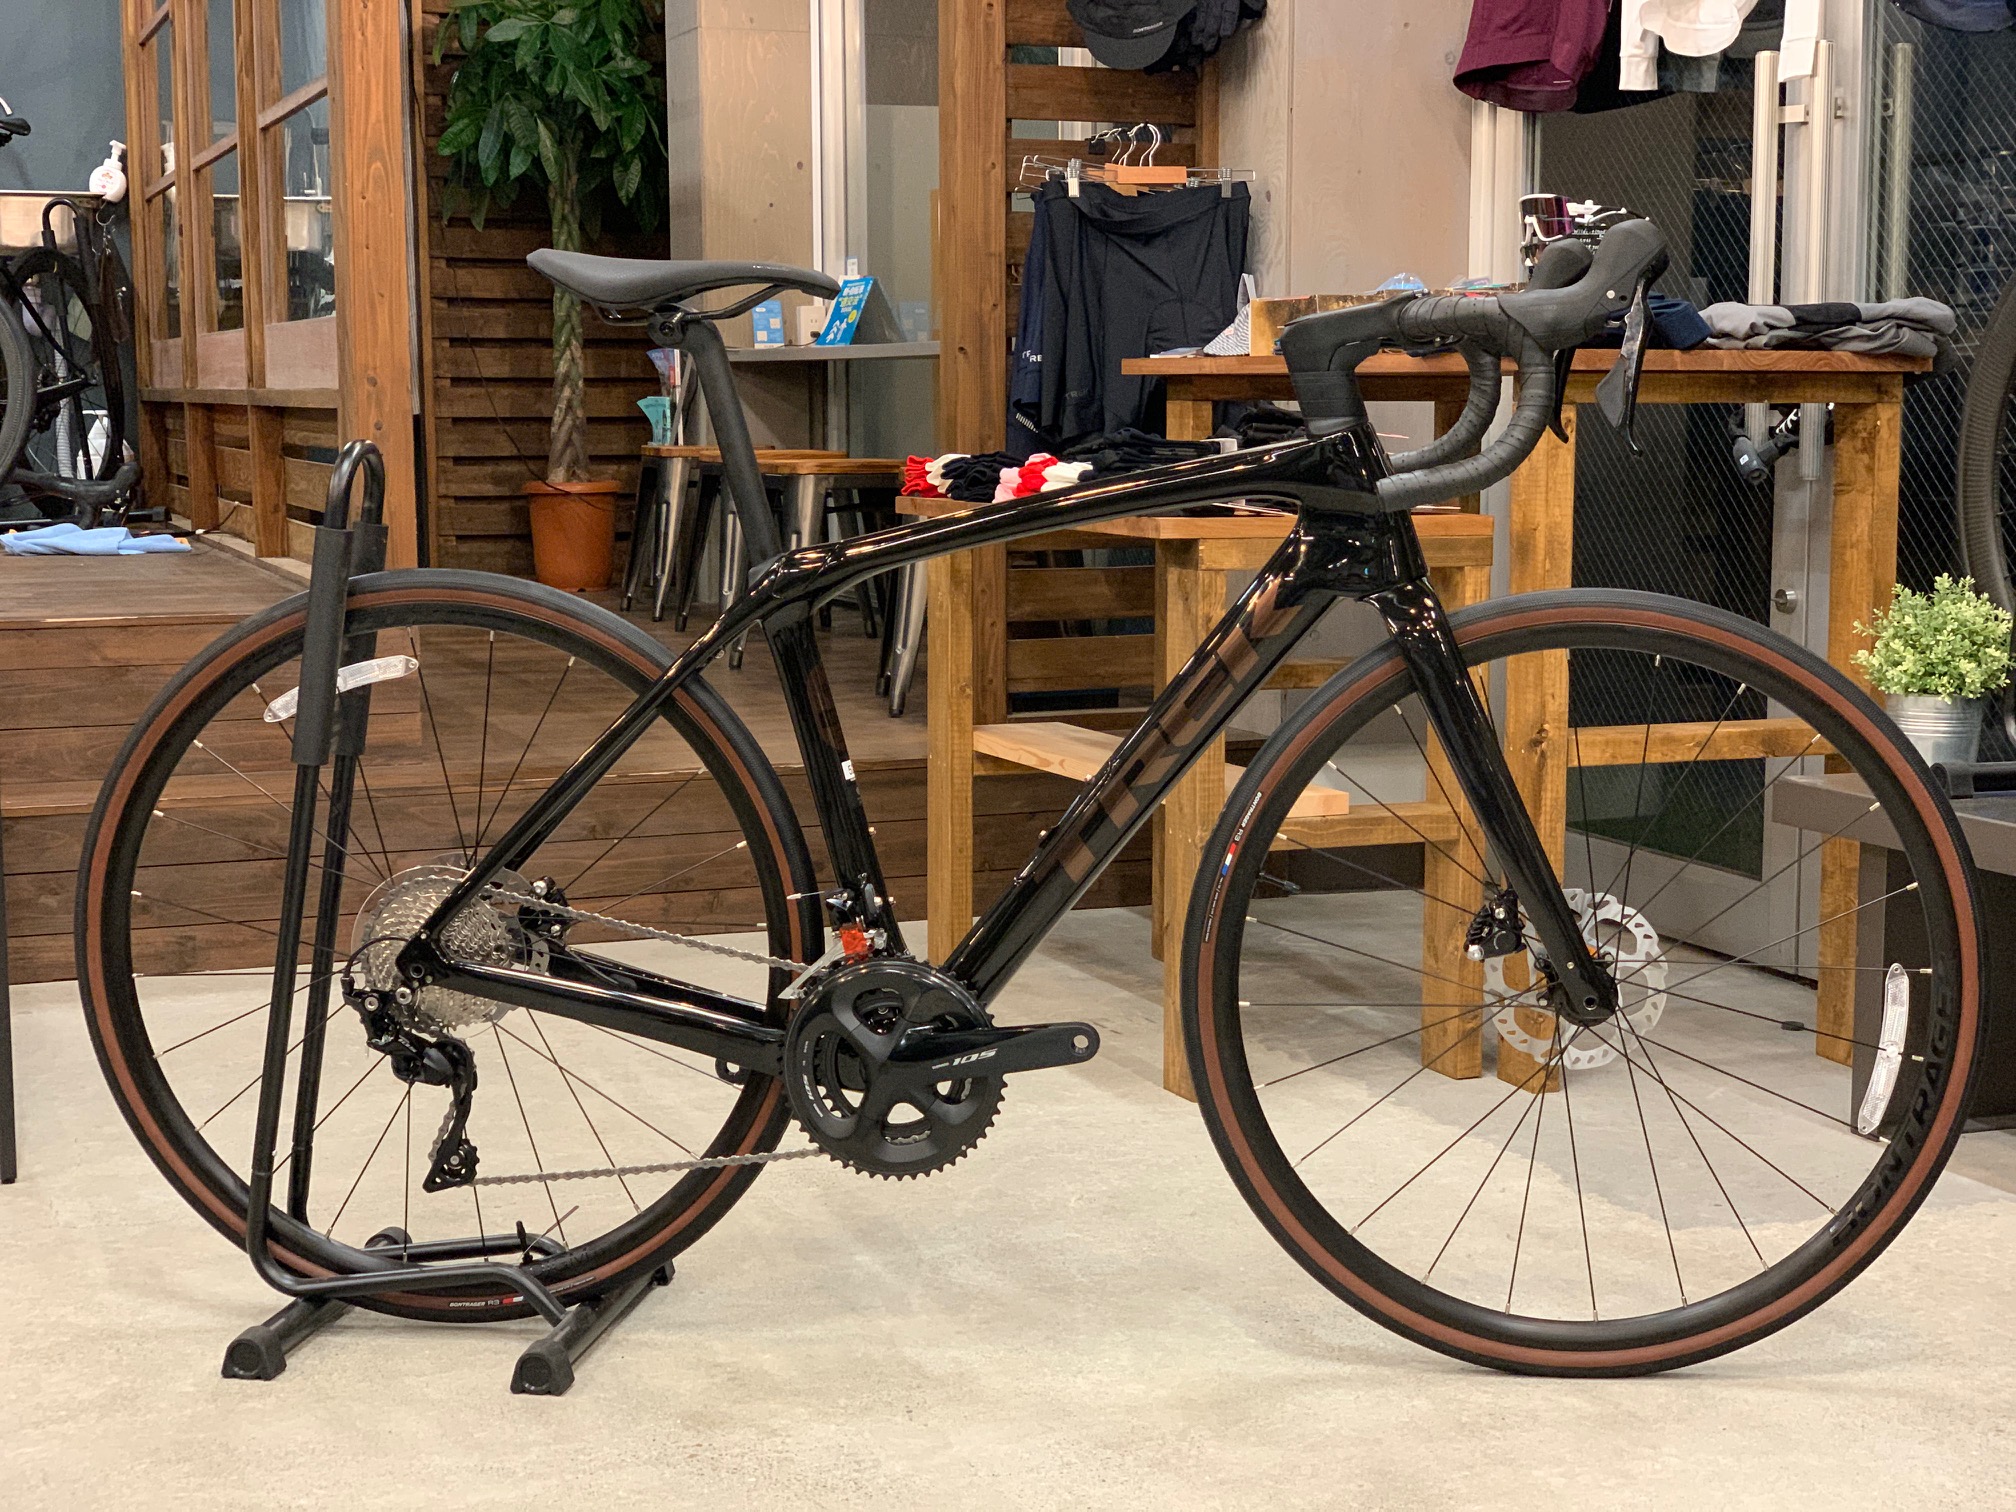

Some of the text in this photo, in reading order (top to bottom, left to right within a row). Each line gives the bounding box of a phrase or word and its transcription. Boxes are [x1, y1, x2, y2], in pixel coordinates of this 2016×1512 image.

[1034, 573, 1304, 884] TREK
[1240, 791, 1262, 828] BONTRAGER
[952, 1048, 998, 1066] 105
